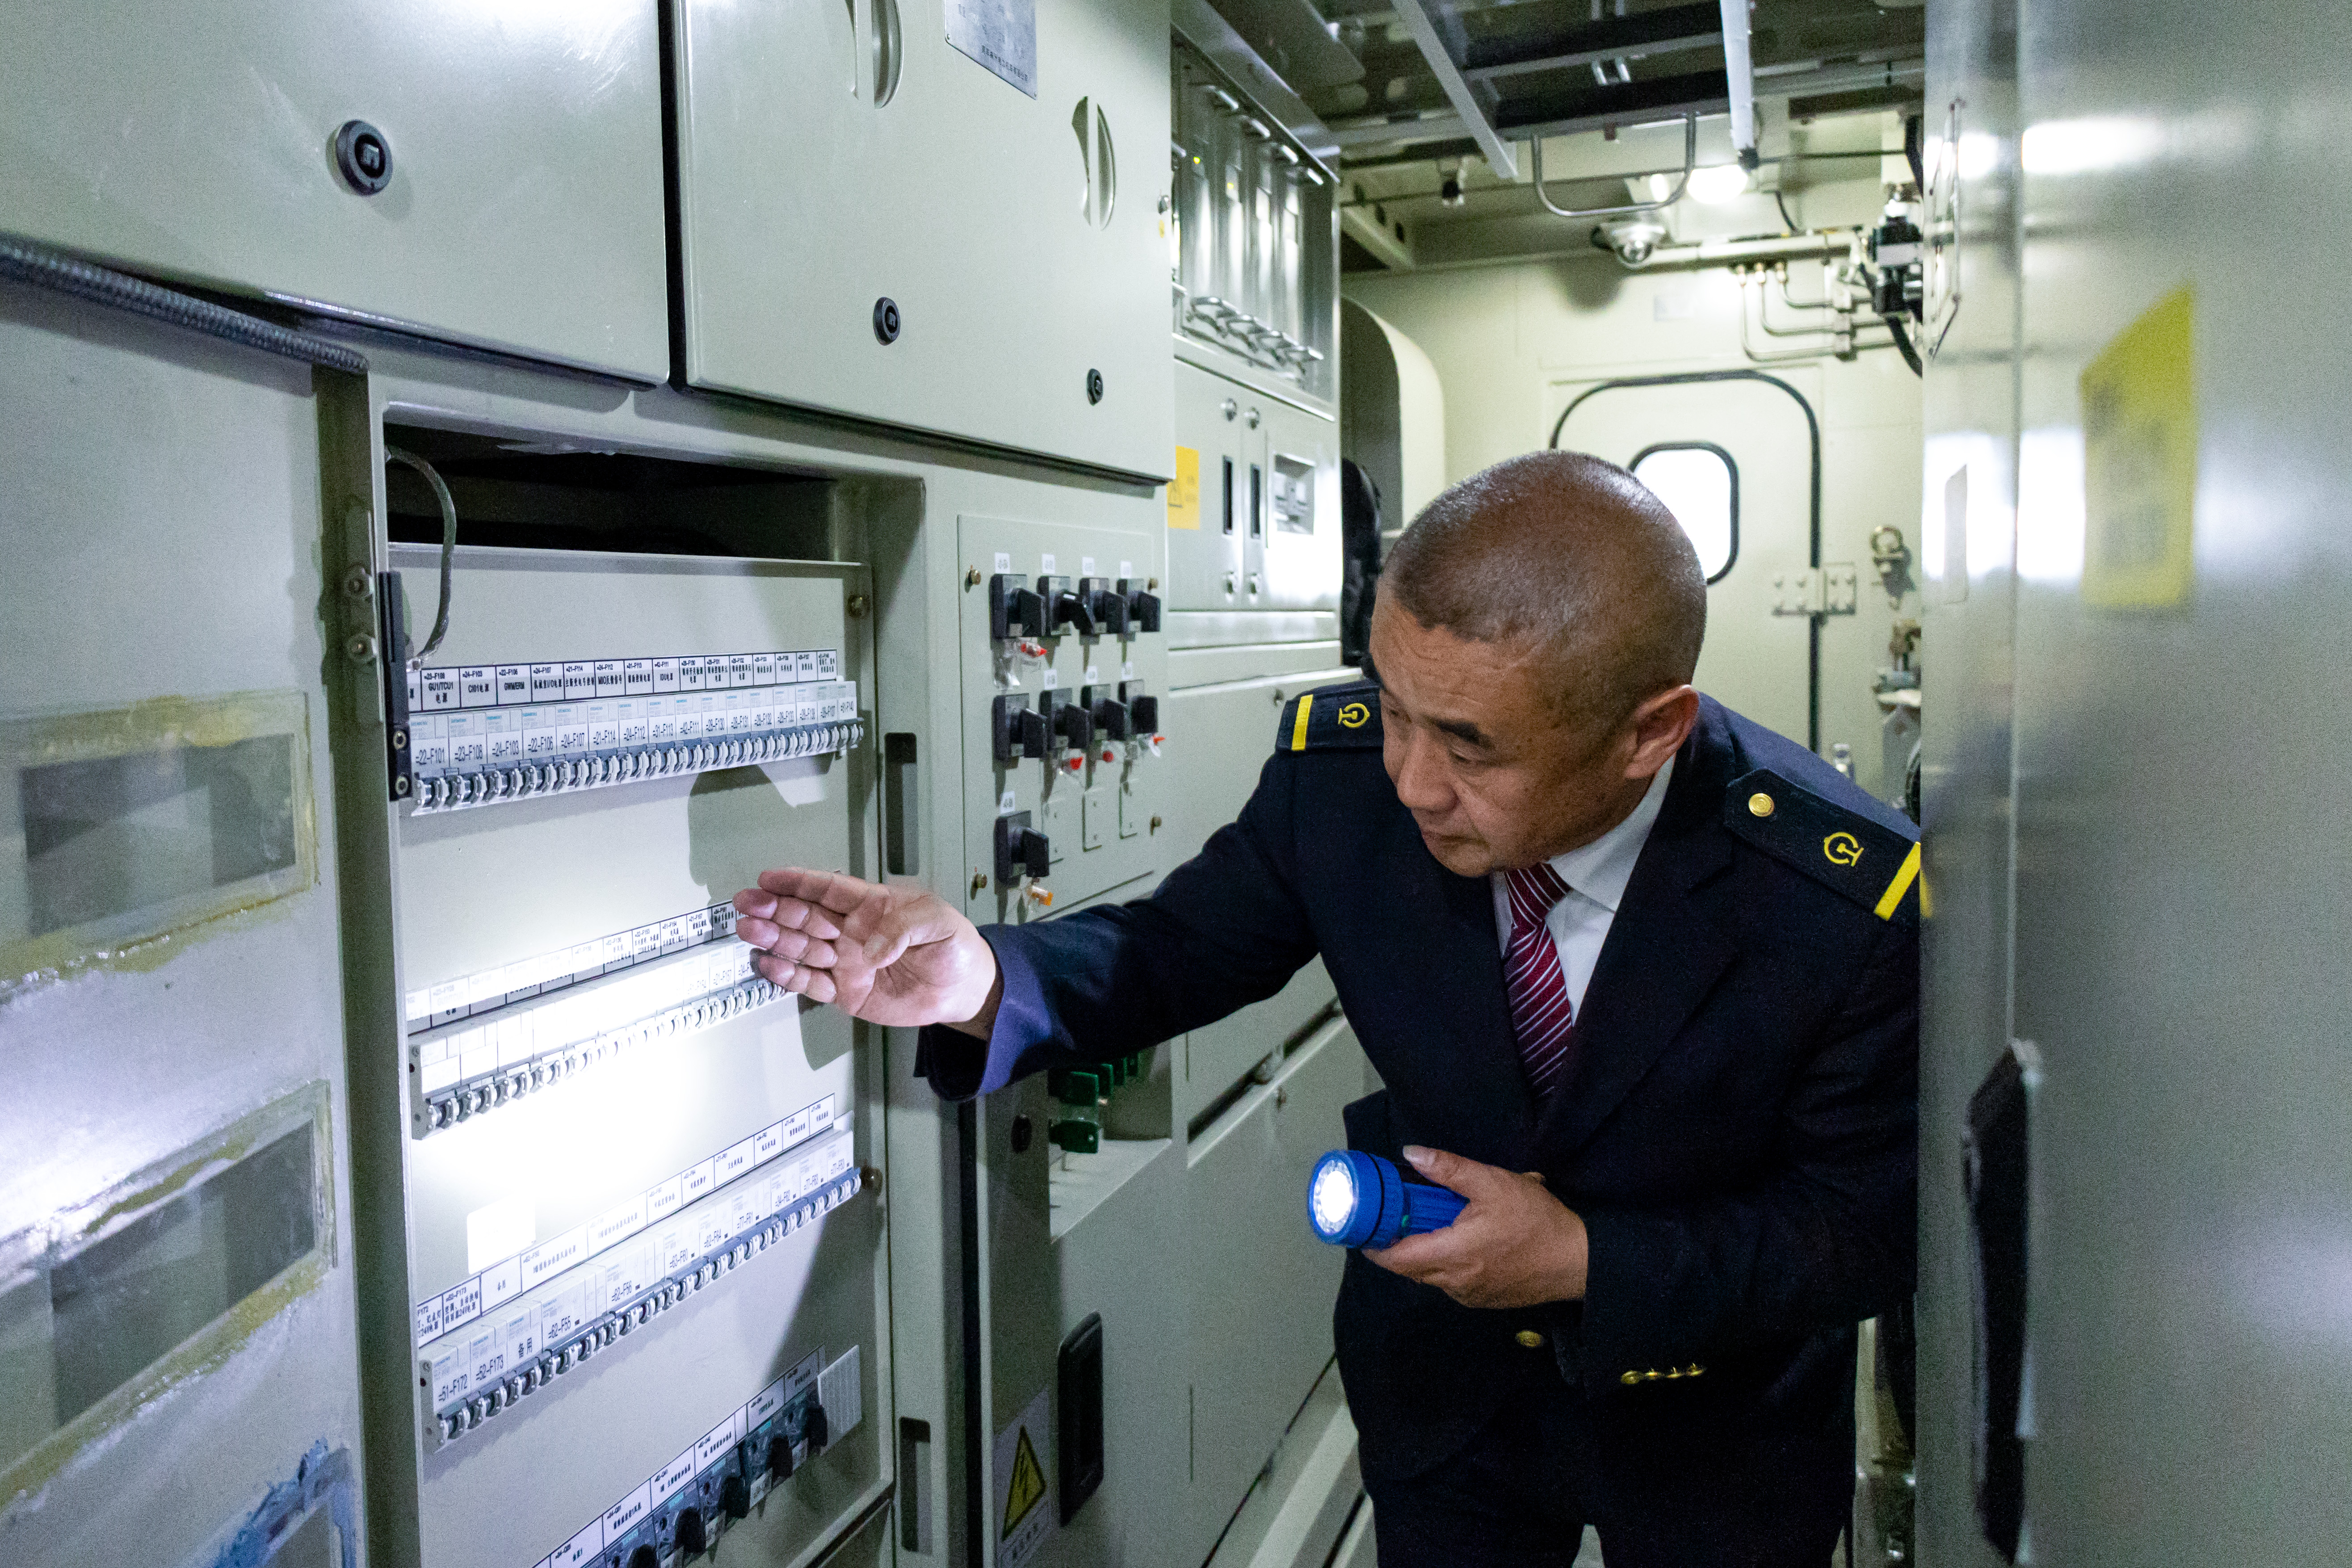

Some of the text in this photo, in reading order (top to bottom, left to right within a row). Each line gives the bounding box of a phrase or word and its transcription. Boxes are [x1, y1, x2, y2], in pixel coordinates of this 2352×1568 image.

[624, 726, 646, 741] =24-F112
[653, 723, 673, 738] =31-F113
[680, 721, 699, 734] =42-F111
[528, 735, 553, 752] =22-F106
[561, 732, 585, 748] =24-F107
[593, 729, 616, 745] =21-F114
[416, 747, 445, 765] =22-F101
[454, 744, 483, 762] =23-F108
[492, 740, 519, 757] =24-F103
[713, 969, 732, 985] =21-F157
[737, 1211, 753, 1229] =77-F61
[612, 1280, 632, 1302] =62-F56
[548, 1316, 571, 1339] =62-F55
[519, 1337, 533, 1359] 备用
[475, 1354, 504, 1381] =52-F173
[438, 1374, 468, 1402] =51-F172
